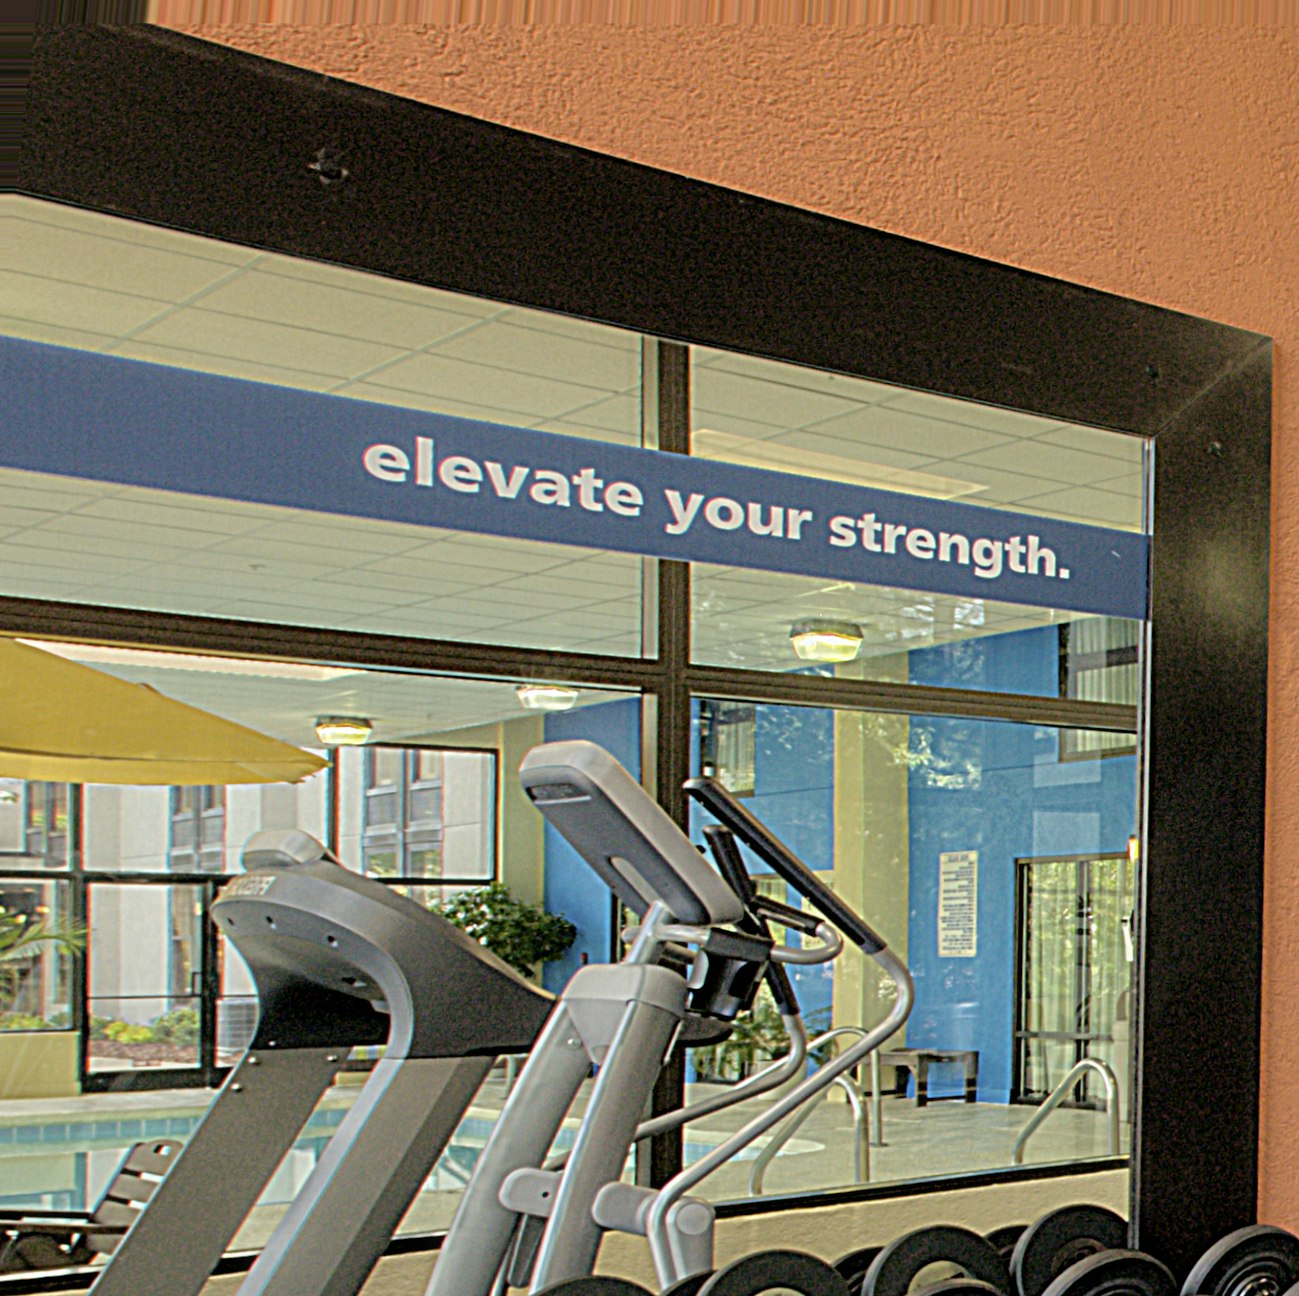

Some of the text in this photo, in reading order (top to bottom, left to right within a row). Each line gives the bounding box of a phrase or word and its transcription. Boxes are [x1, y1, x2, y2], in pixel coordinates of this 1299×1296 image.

[362, 436, 1072, 580] elevate your strength.
